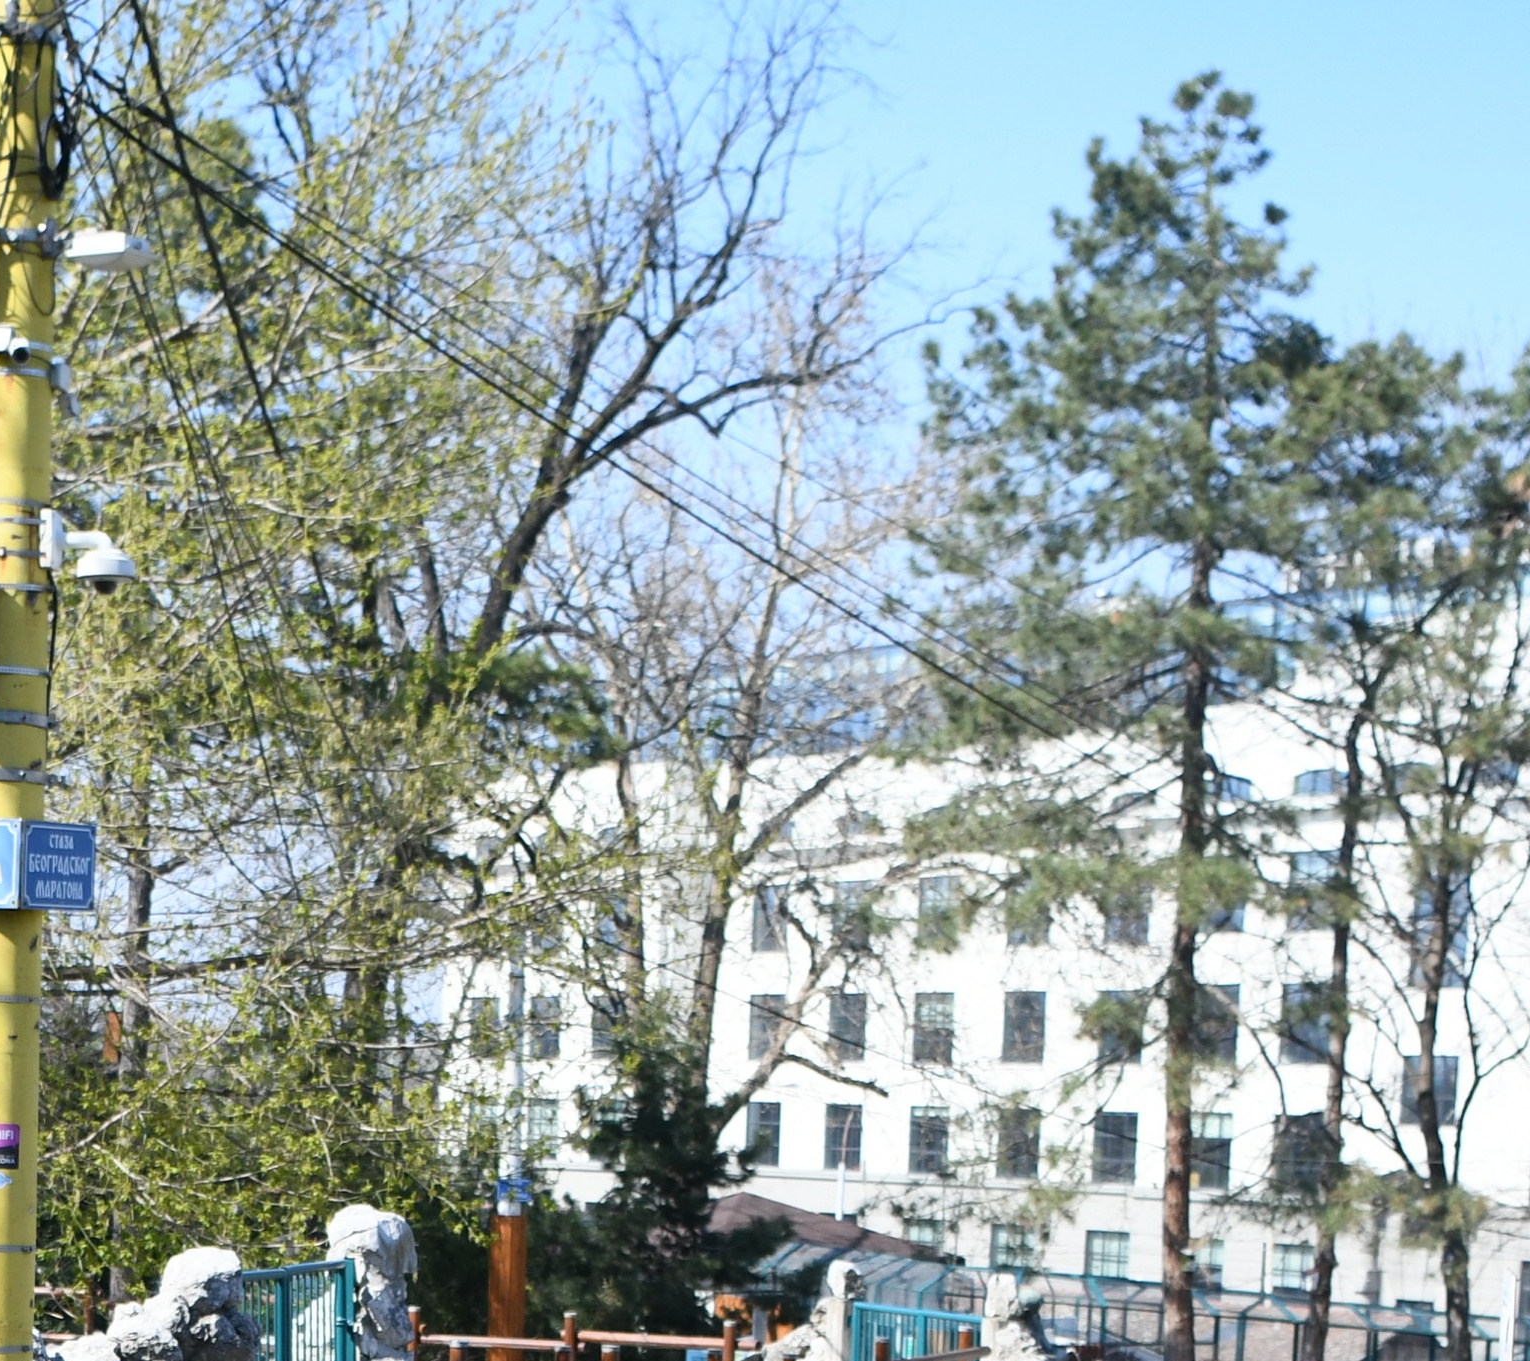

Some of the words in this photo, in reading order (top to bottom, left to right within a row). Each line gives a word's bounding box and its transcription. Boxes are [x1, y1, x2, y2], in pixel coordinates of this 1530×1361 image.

[49, 834, 74, 850] СТАЗА
[29, 853, 91, 876] БЕОГРАДСКОГ
[35, 880, 83, 900] МАРАТОНА
